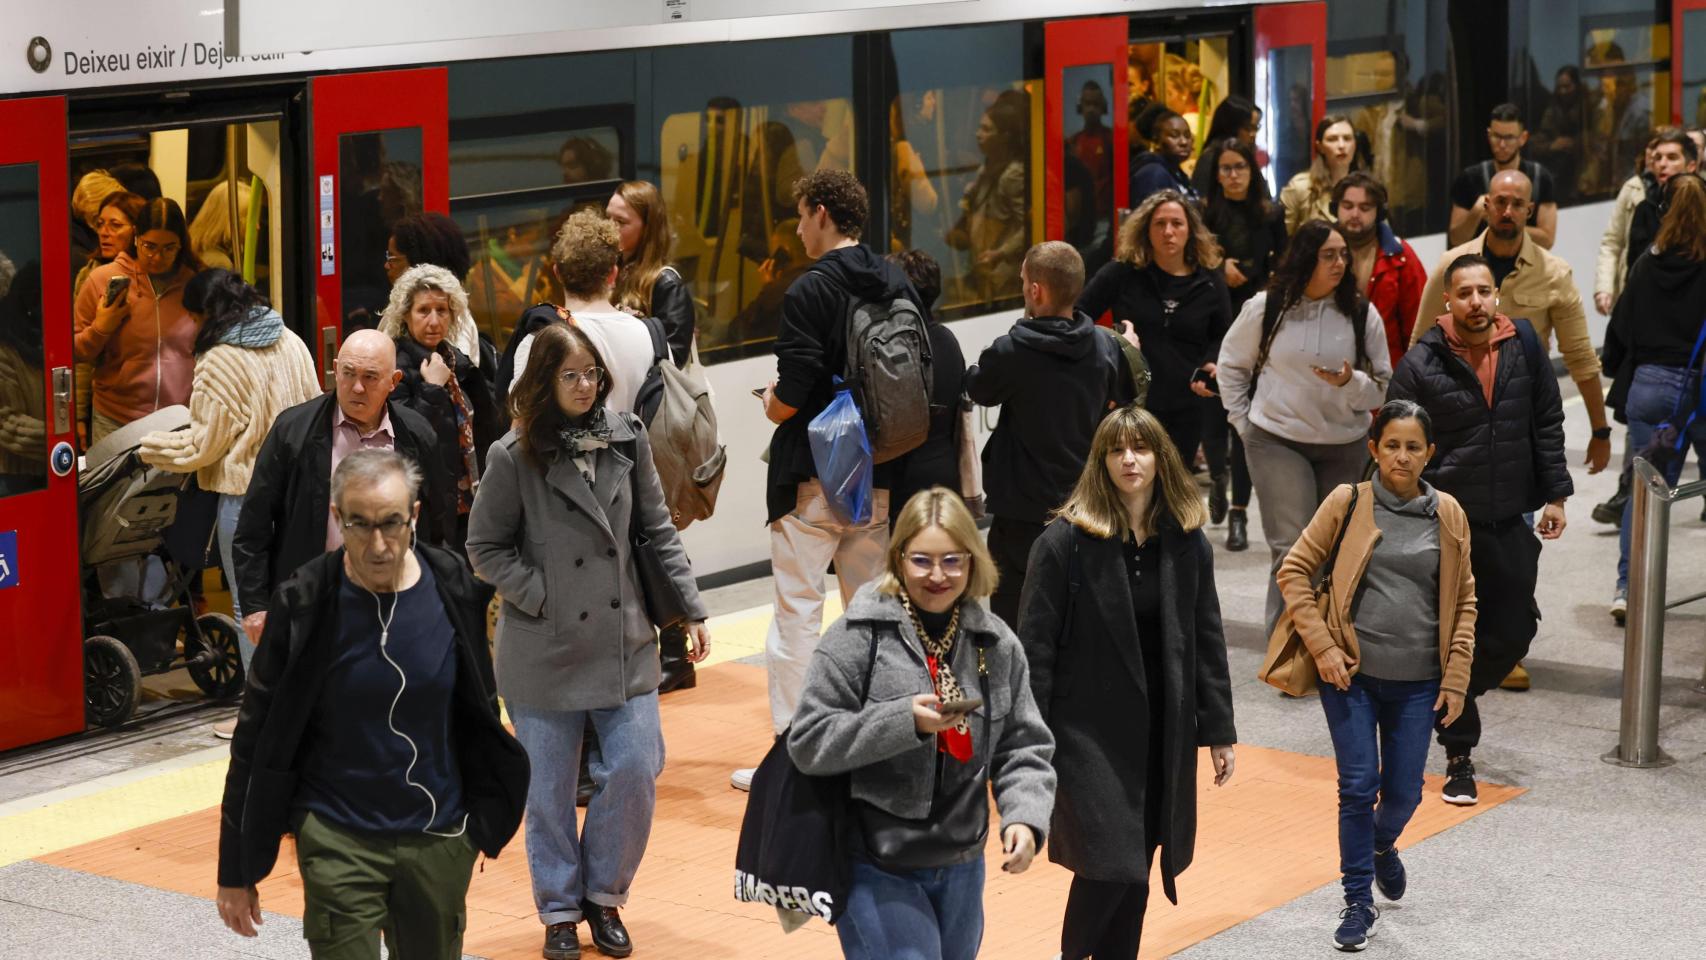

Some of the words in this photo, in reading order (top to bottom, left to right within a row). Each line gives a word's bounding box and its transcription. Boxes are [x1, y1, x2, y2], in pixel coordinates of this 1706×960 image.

[64, 50, 130, 75] Deixeu
[136, 44, 175, 70] eixir
[180, 42, 188, 67] /
